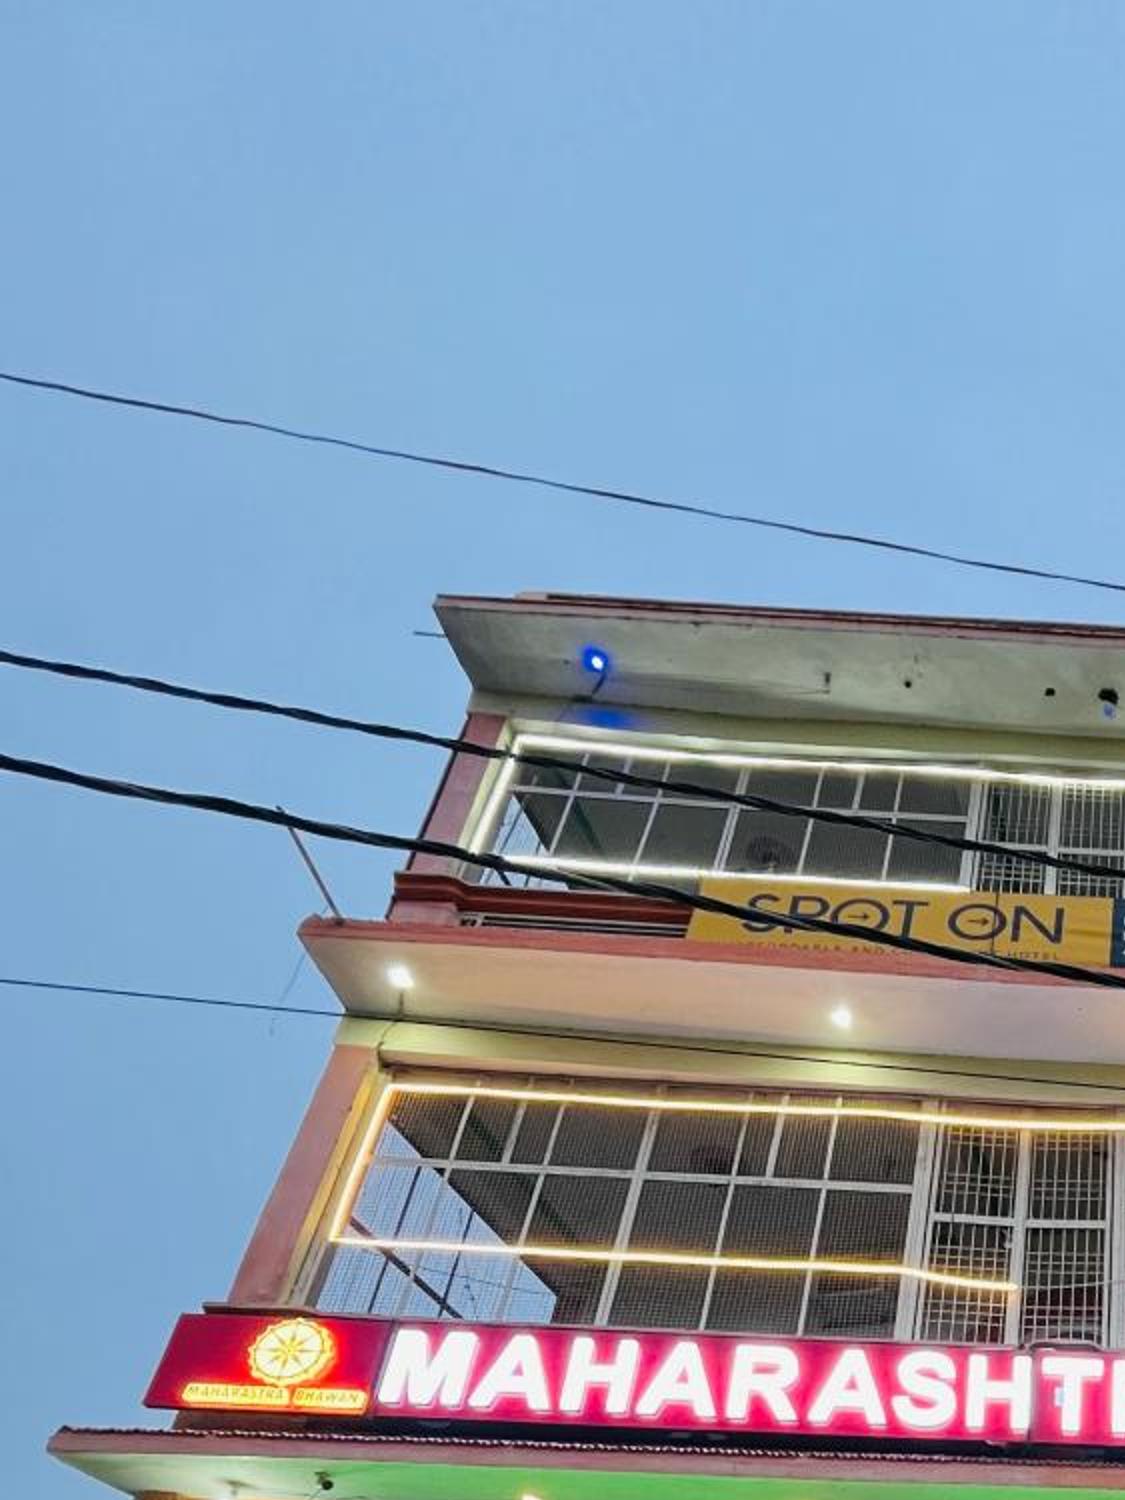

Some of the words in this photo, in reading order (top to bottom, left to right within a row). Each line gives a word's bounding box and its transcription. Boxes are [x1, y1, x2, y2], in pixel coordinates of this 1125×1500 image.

[741, 893, 930, 940] SPOT
[947, 903, 1066, 944] ON
[296, 1389, 359, 1403] BHAWAN
